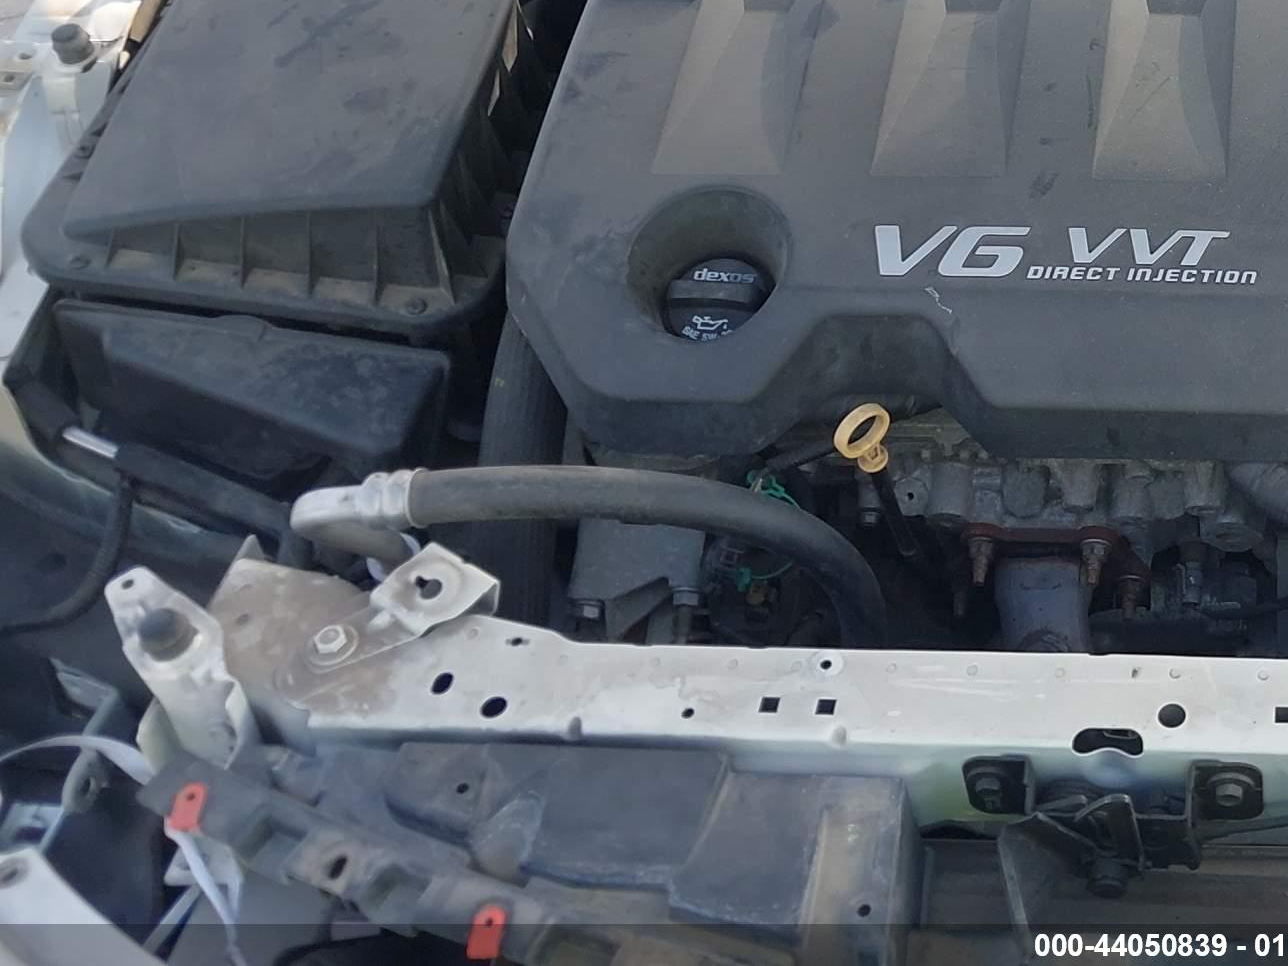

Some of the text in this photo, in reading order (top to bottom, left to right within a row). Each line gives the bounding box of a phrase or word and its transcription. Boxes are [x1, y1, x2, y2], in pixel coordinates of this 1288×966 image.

[875, 225, 1231, 277] V6 VVT
[693, 268, 757, 283] dexos
[1026, 265, 1258, 284] DIRECT INJECTION
